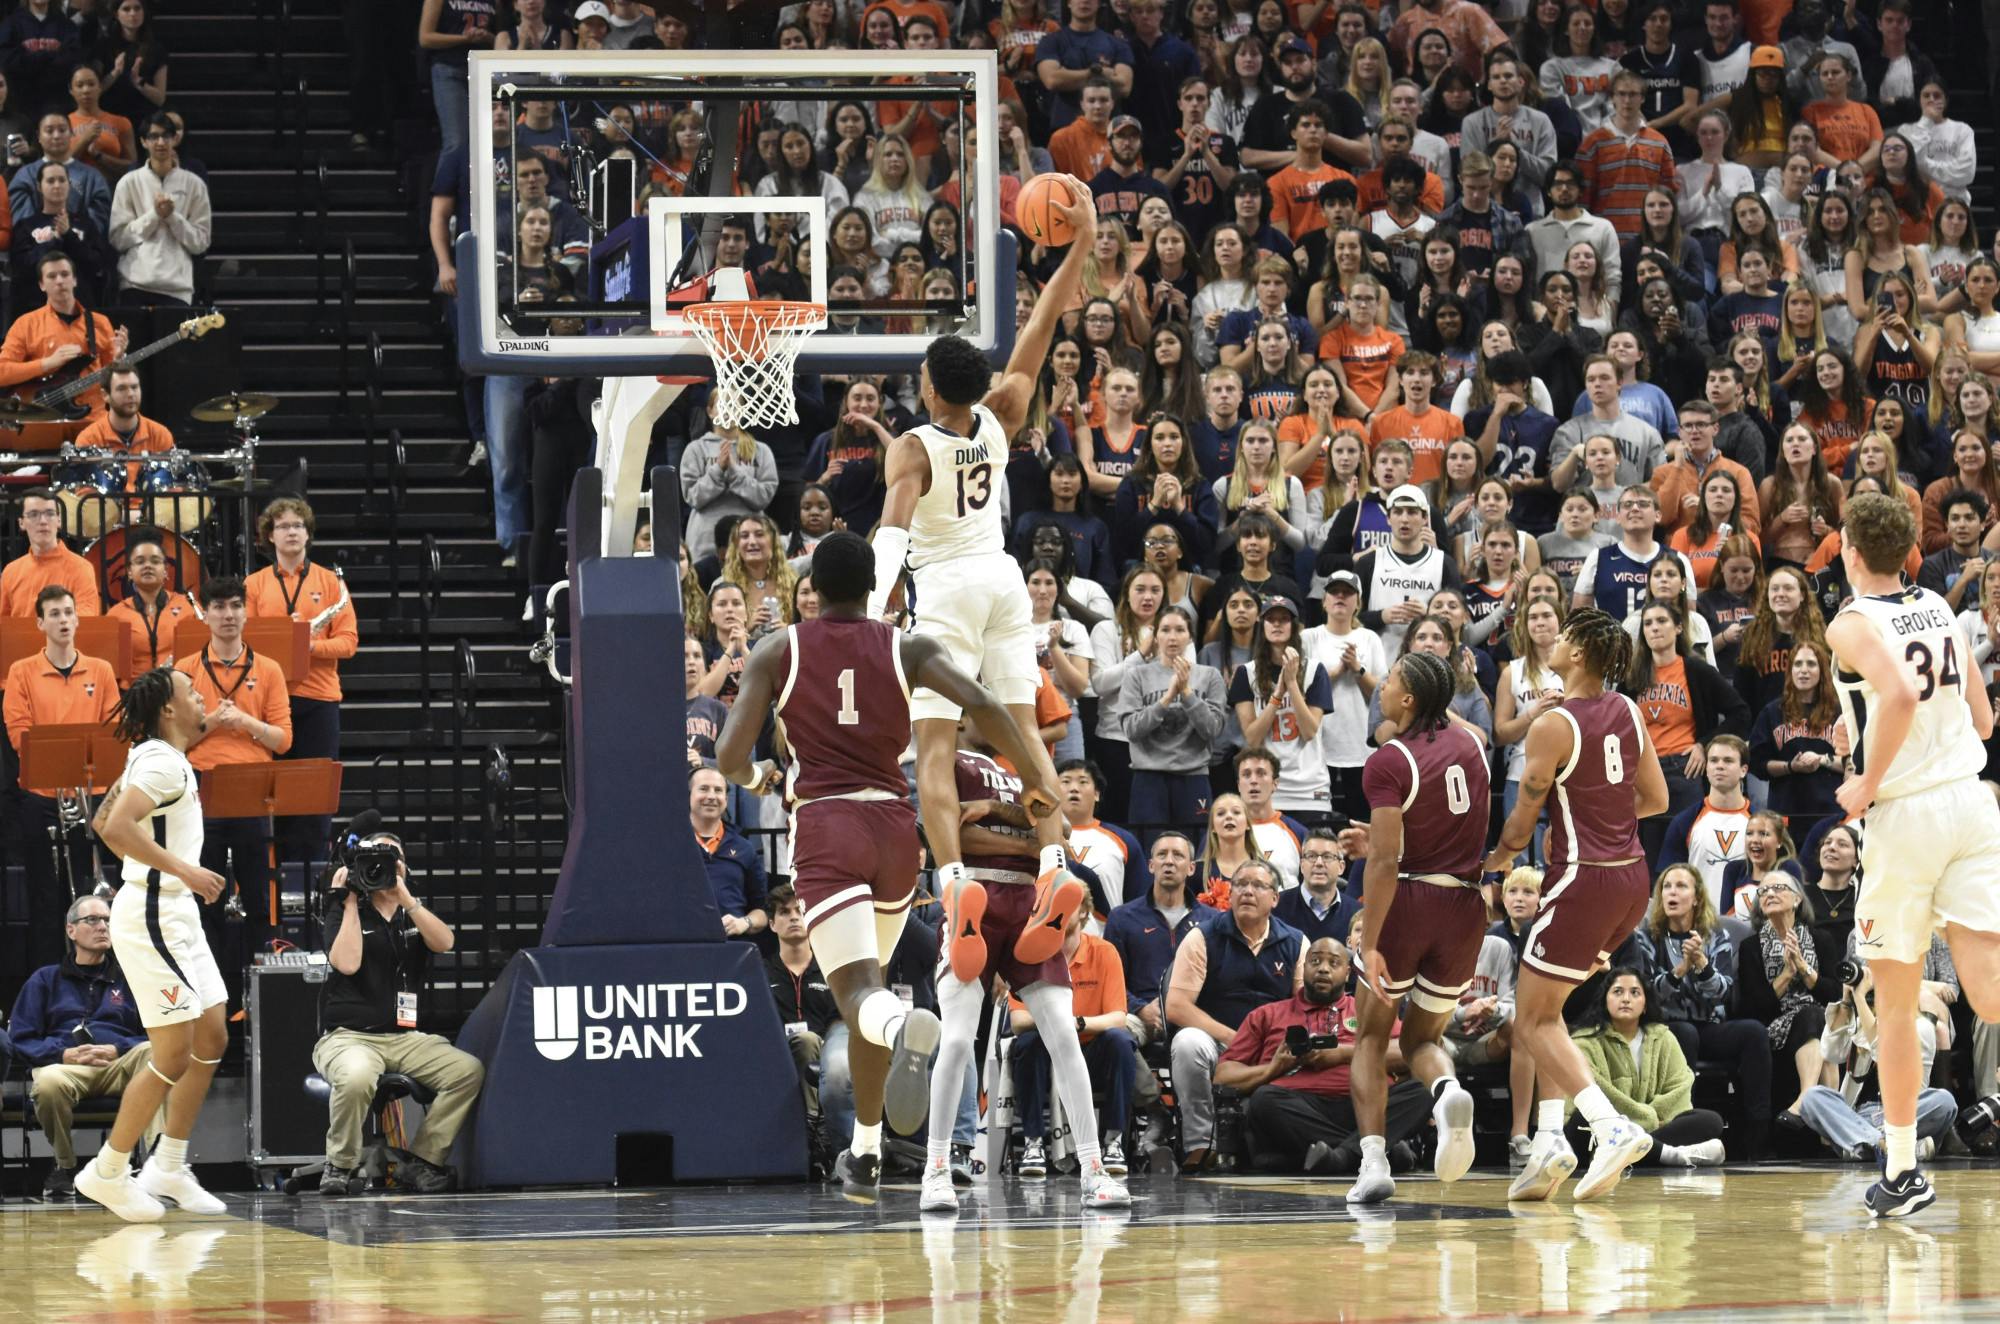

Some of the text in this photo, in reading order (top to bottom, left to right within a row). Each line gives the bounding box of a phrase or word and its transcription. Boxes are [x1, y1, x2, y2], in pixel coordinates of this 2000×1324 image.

[1655, 91, 1662, 112] 1
[1183, 175, 1214, 205] 30
[498, 340, 550, 354] SPALDING
[955, 441, 990, 466] DUNN
[956, 462, 992, 518] 13
[1379, 577, 1436, 592] VIRGINIA
[1613, 572, 1648, 584] VIRGI
[1891, 608, 1950, 637] GROVES
[1904, 636, 1961, 702] 34
[837, 668, 860, 725] 1
[1272, 712, 1300, 742] 13
[1603, 733, 1624, 785] 8
[1444, 764, 1471, 815] 0
[583, 982, 748, 1020] UNITED
[585, 1024, 704, 1060] BANK
